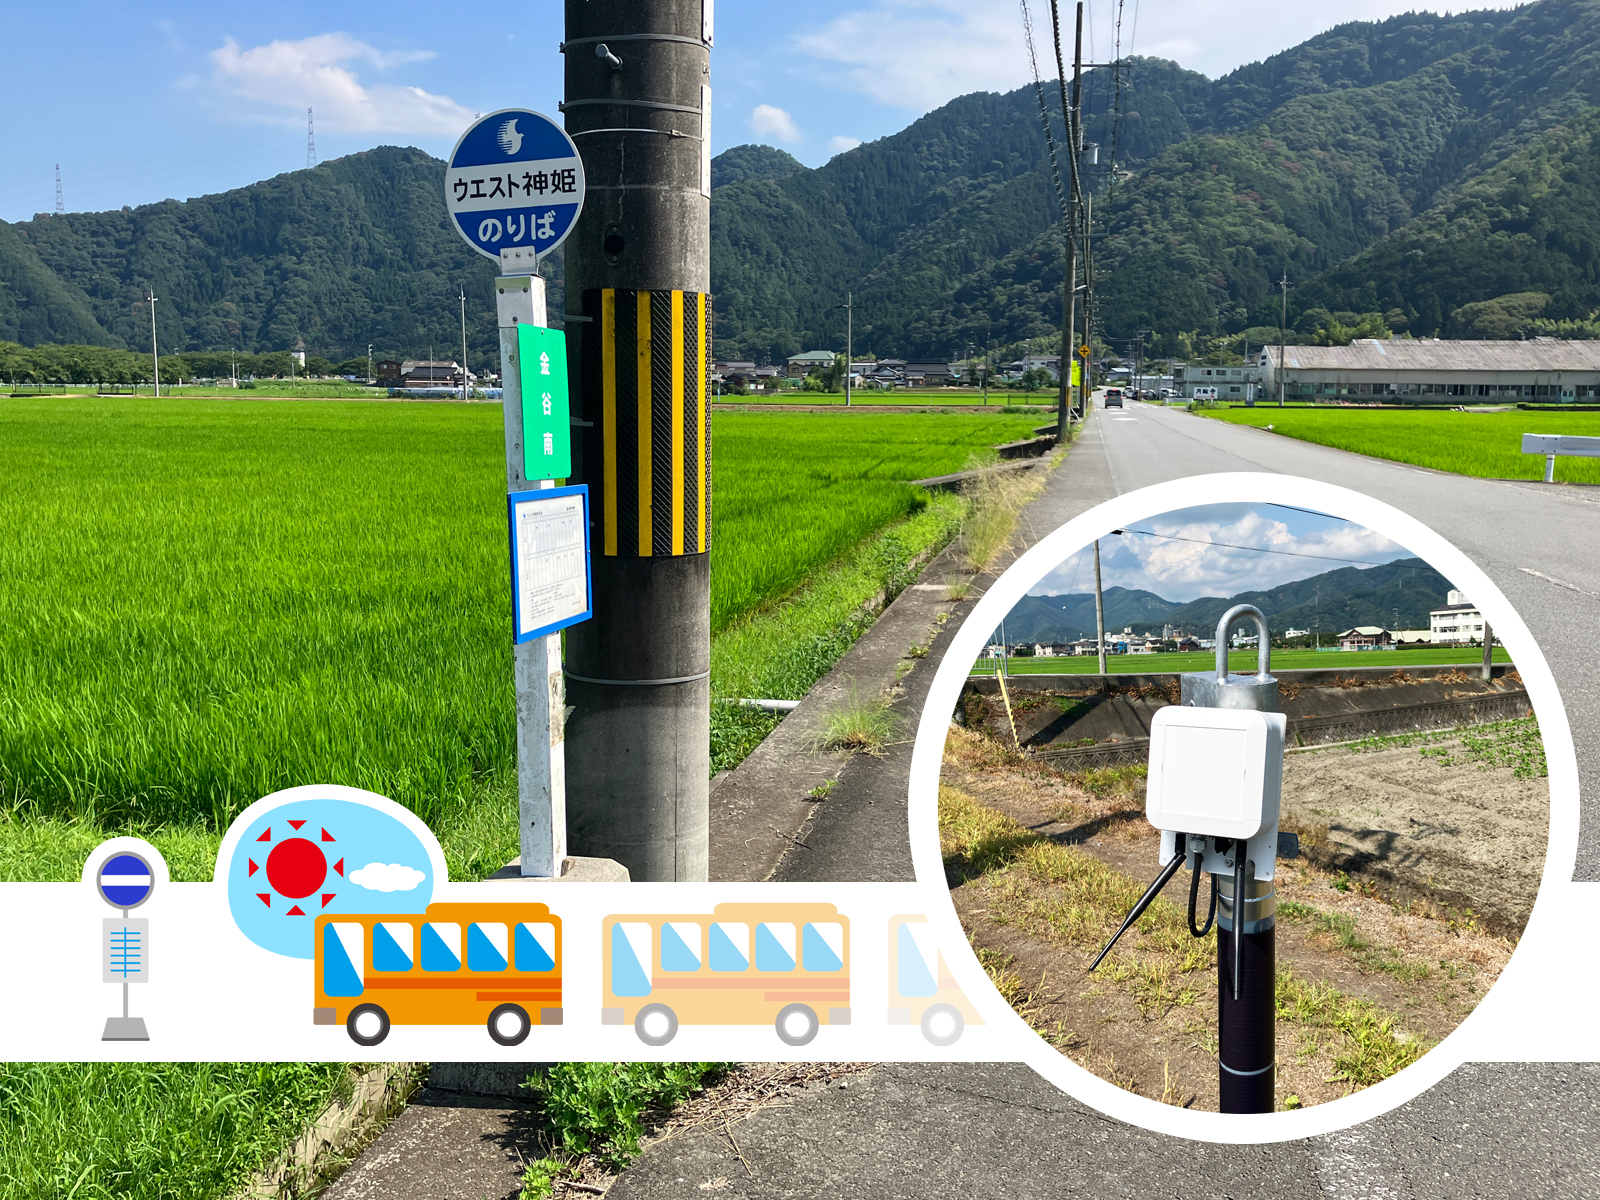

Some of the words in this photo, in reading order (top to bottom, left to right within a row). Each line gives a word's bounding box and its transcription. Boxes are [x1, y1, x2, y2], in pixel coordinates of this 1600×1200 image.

[453, 168, 577, 202] ウエスト神姫
[478, 210, 556, 243] のりば
[539, 351, 554, 456] 金谷南
